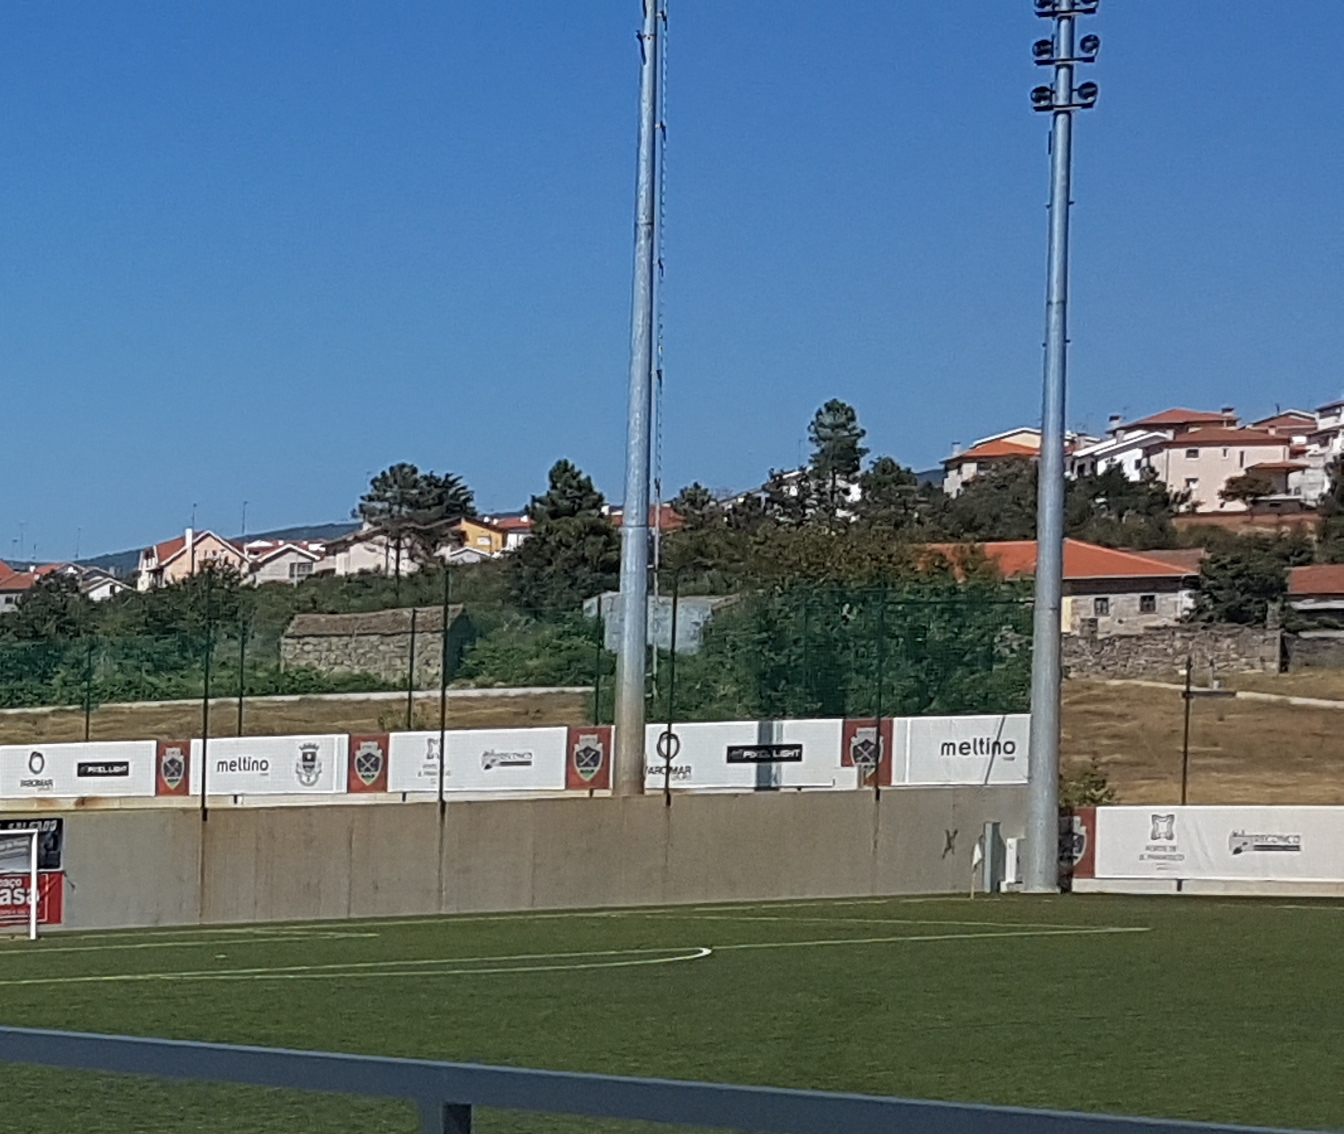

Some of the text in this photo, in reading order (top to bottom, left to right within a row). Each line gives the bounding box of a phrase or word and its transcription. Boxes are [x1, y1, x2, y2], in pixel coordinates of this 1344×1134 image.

[773, 749, 801, 758] LIGHT
[940, 737, 1016, 756] meltino
[216, 756, 270, 772] meltino
